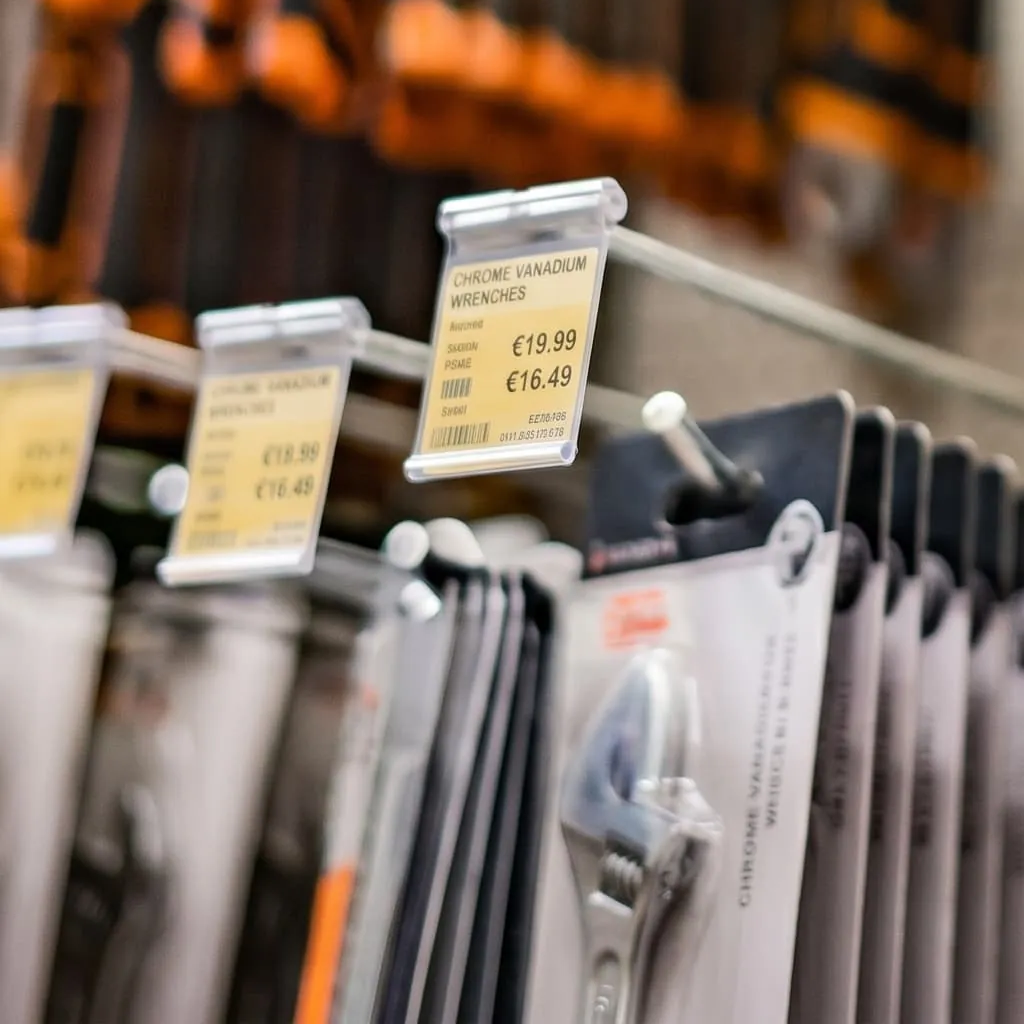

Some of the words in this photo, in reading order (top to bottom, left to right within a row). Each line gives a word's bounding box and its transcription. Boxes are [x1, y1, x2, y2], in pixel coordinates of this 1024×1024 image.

[453, 265, 512, 288] CHROME
[516, 256, 587, 279] VANADIUM
[450, 285, 527, 309] WRENCHES
[512, 329, 577, 357] €19.99
[506, 365, 572, 393] €16.49
